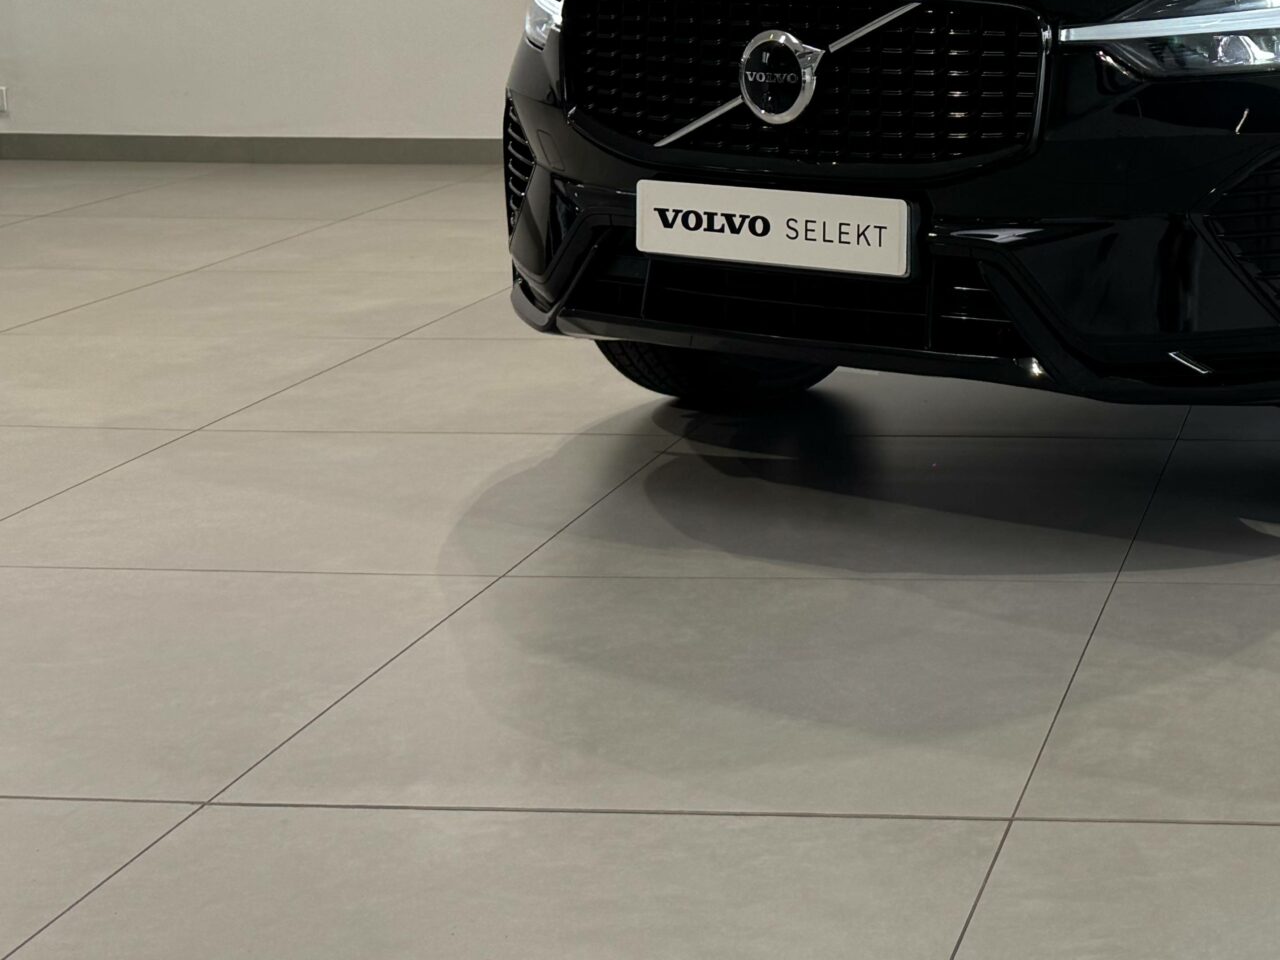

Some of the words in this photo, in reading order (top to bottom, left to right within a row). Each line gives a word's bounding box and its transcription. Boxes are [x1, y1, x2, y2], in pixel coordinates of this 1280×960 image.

[745, 71, 798, 84] VOLVO
[654, 207, 771, 238] VOLVO
[785, 217, 888, 248] SELEKT
